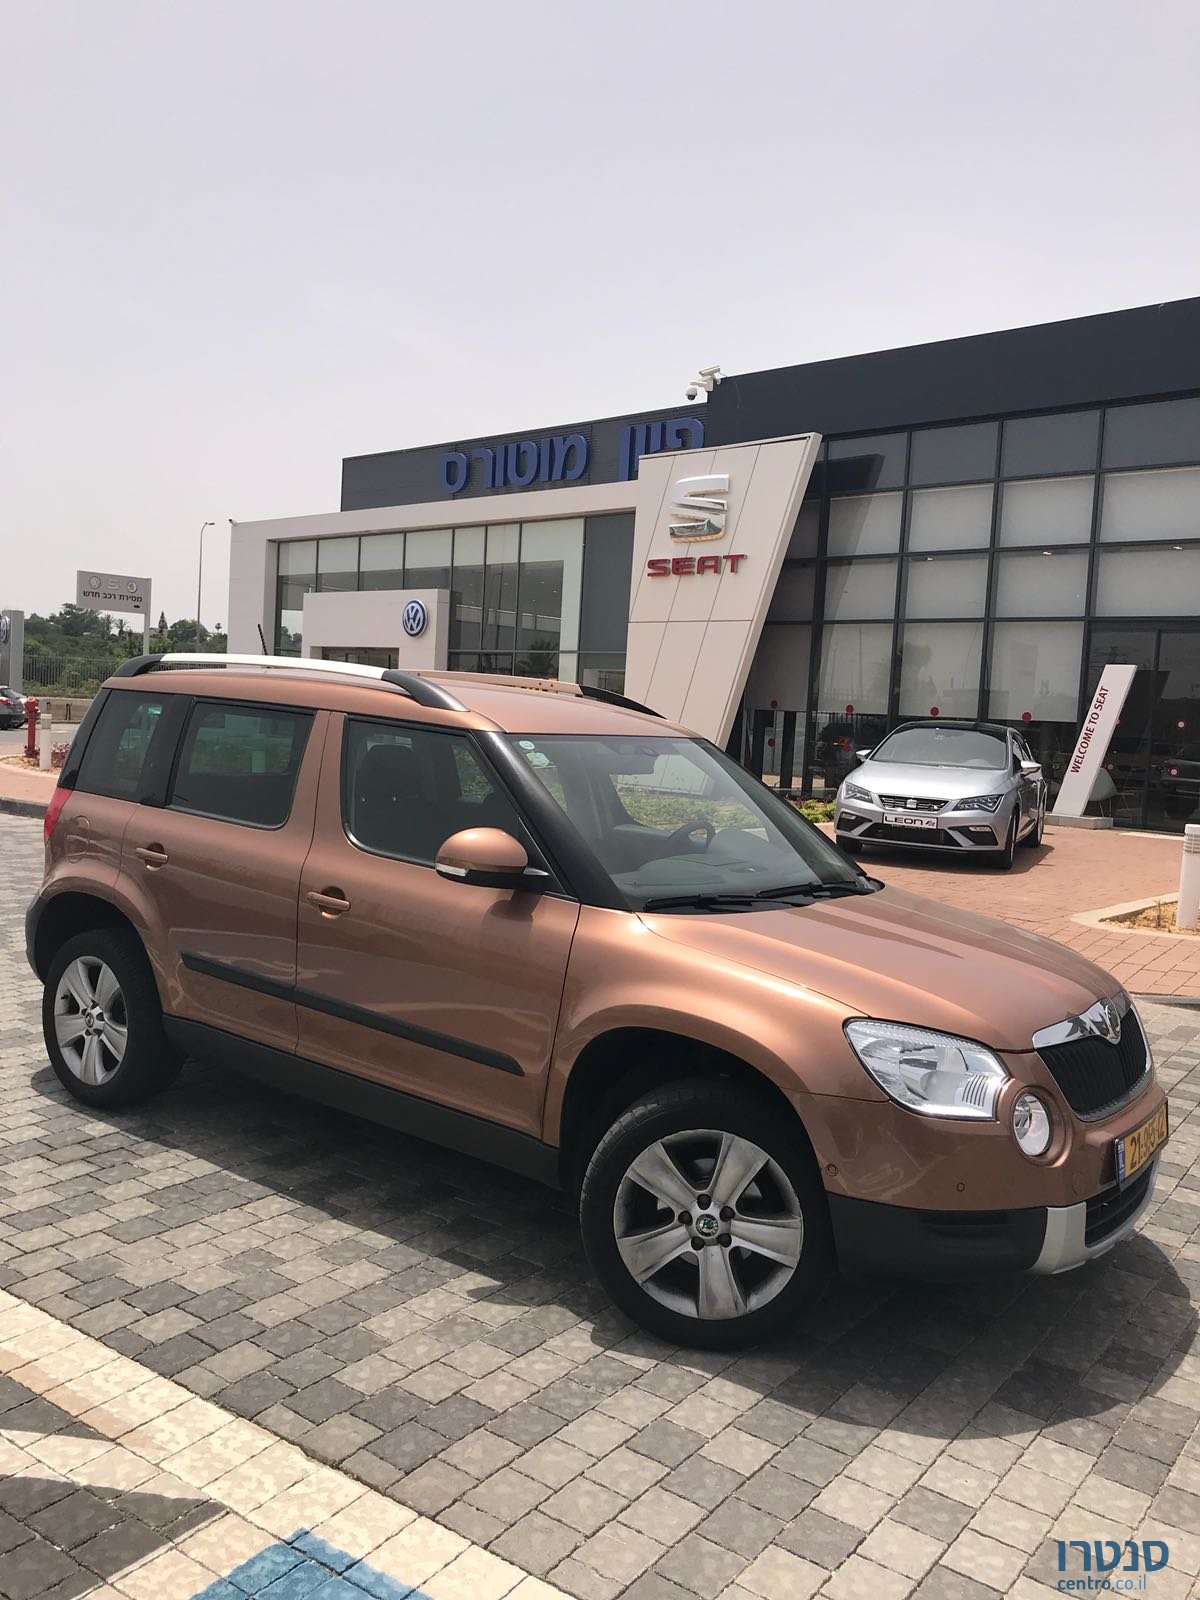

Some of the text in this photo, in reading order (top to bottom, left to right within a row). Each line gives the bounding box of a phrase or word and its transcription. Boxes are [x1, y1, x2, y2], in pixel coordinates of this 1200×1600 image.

[440, 434, 588, 493] מוטורס
[646, 553, 748, 578] SEAT
[83, 590, 143, 603] מסירת רכב חדש
[1070, 685, 1109, 774] WELCOME TO SEAT
[884, 815, 924, 826] LEON
